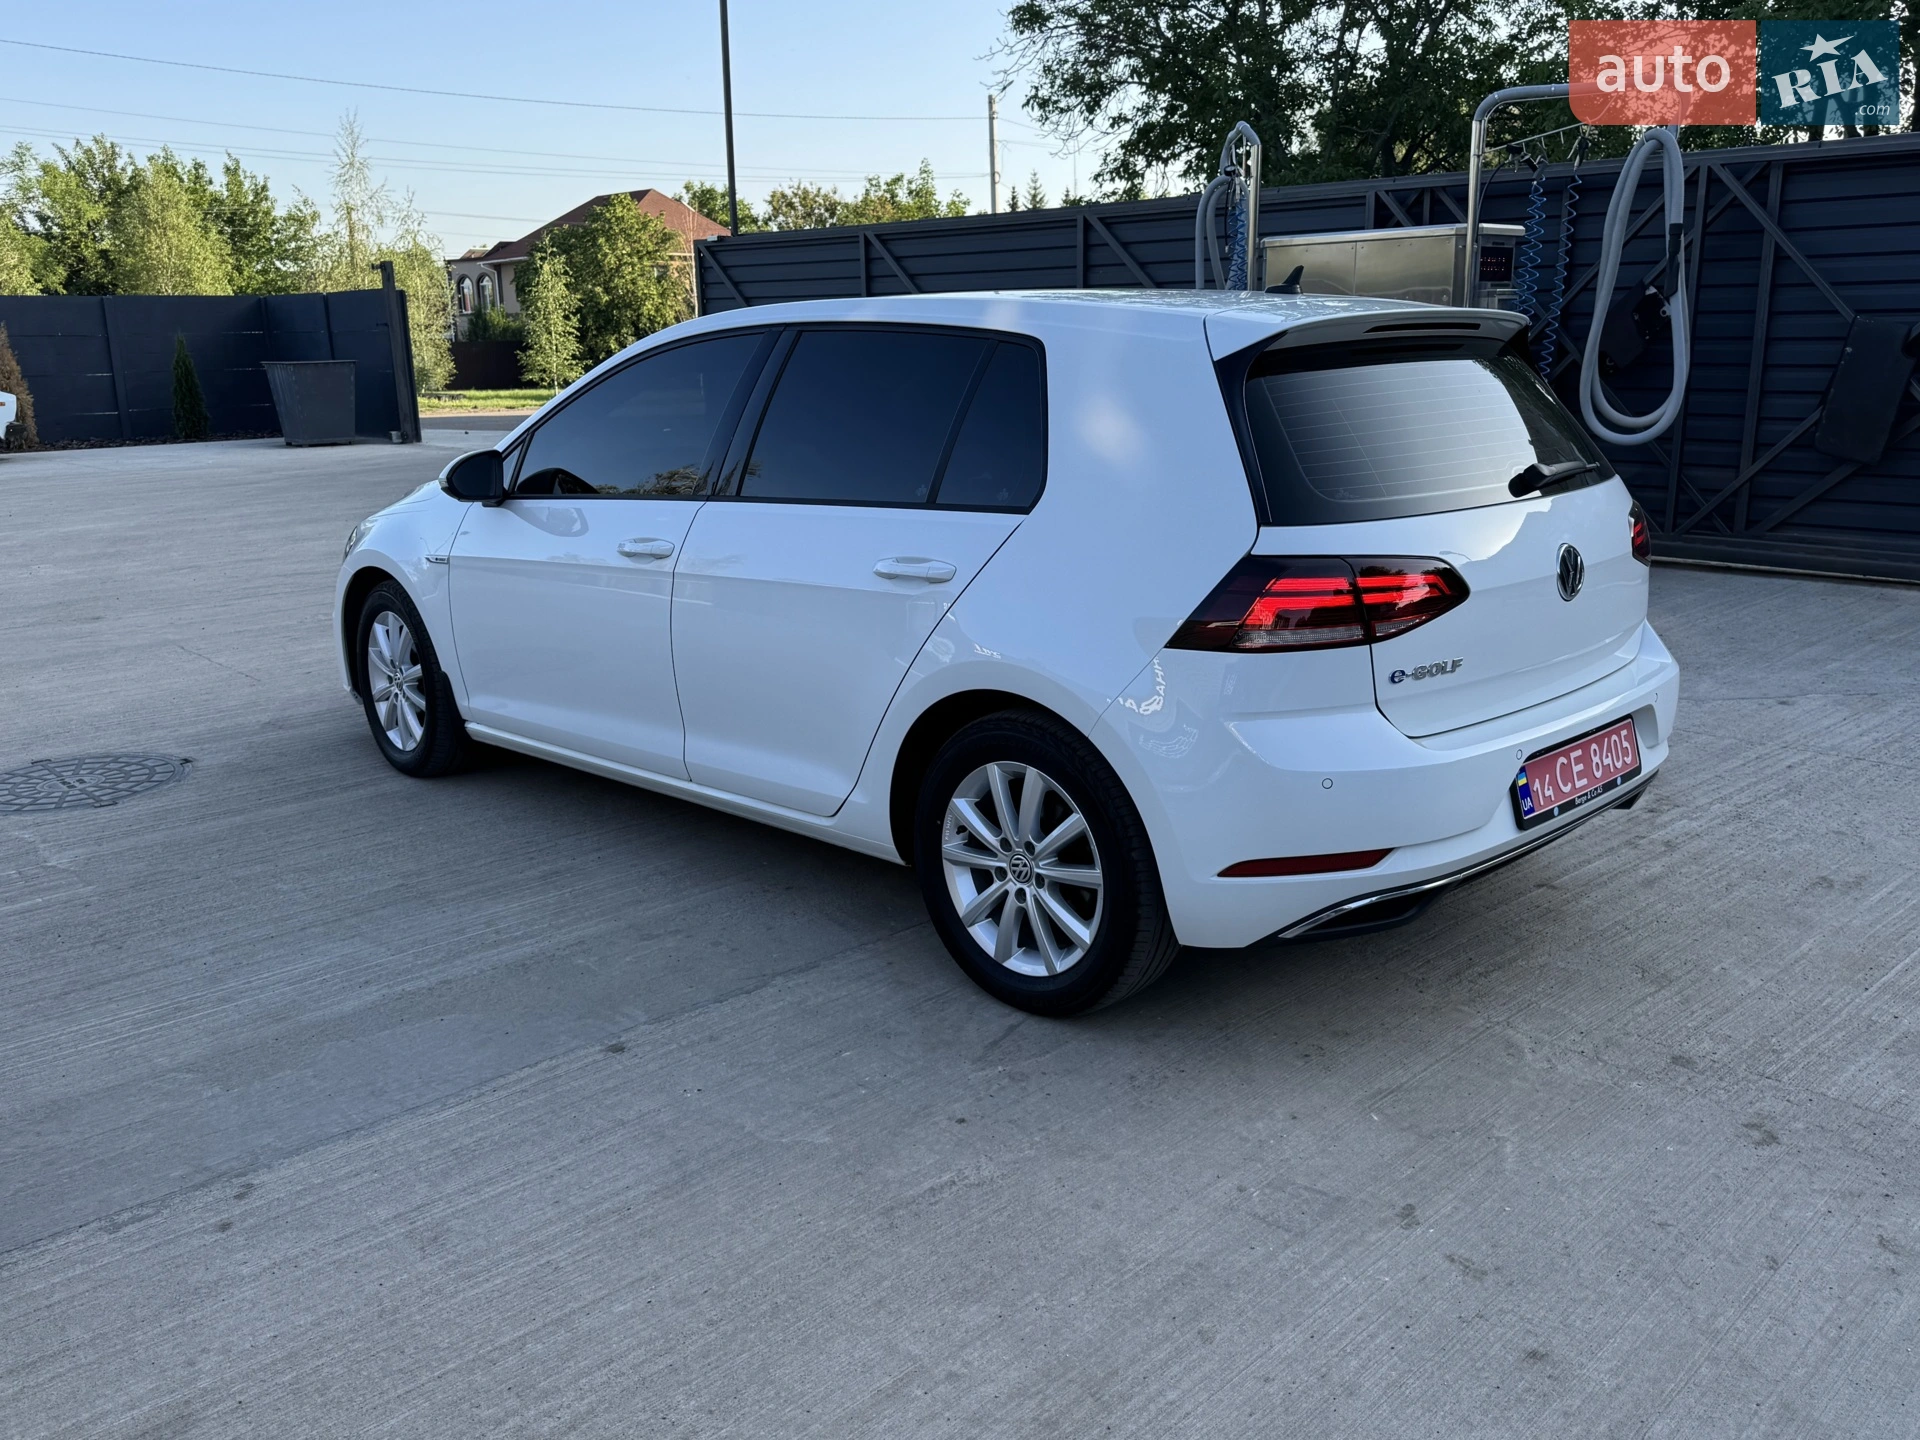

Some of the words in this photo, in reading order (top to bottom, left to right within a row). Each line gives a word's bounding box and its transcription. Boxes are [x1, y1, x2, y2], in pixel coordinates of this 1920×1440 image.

[1388, 656, 1464, 684] e-GOLF
[1533, 774, 1555, 806] 14
[1556, 749, 1588, 794] CE
[1590, 729, 1633, 779] 8405
[1521, 797, 1533, 811] UA
